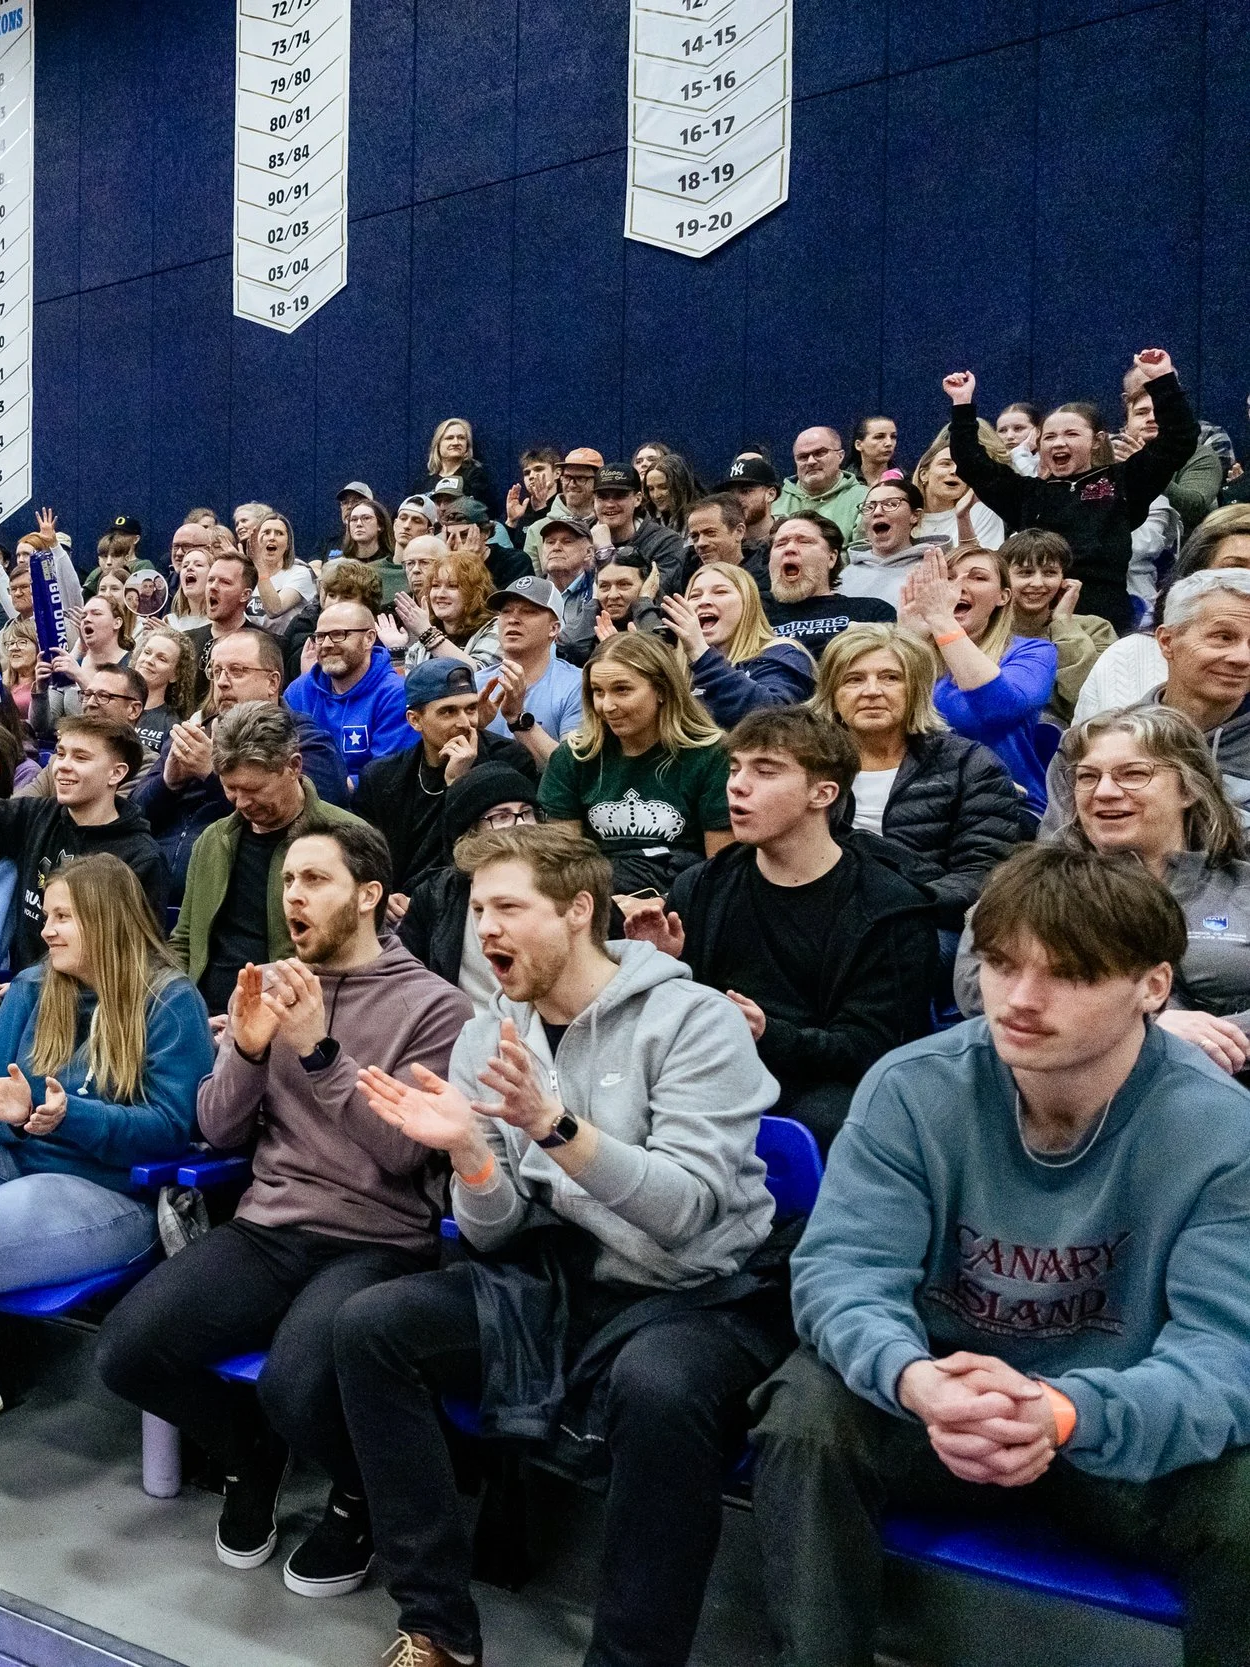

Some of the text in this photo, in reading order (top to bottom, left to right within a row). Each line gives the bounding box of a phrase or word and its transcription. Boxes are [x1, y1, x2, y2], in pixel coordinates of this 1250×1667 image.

[271, 29, 311, 57] 73/74
[681, 24, 738, 56] 14-15
[270, 67, 311, 95] 79/80
[680, 70, 737, 101] 15-16
[269, 106, 311, 132] 80/81
[679, 115, 735, 146] 16-17
[268, 144, 310, 170] 83/84
[677, 163, 735, 192] 18-19
[268, 182, 310, 207] 90/91
[267, 220, 309, 244] 02/03
[675, 211, 733, 238] 19-20
[268, 258, 309, 282] 03/04
[269, 294, 309, 318] 18-19
[49, 582, 69, 652] GO OOKS
[956, 1224, 1131, 1284] CANARY
